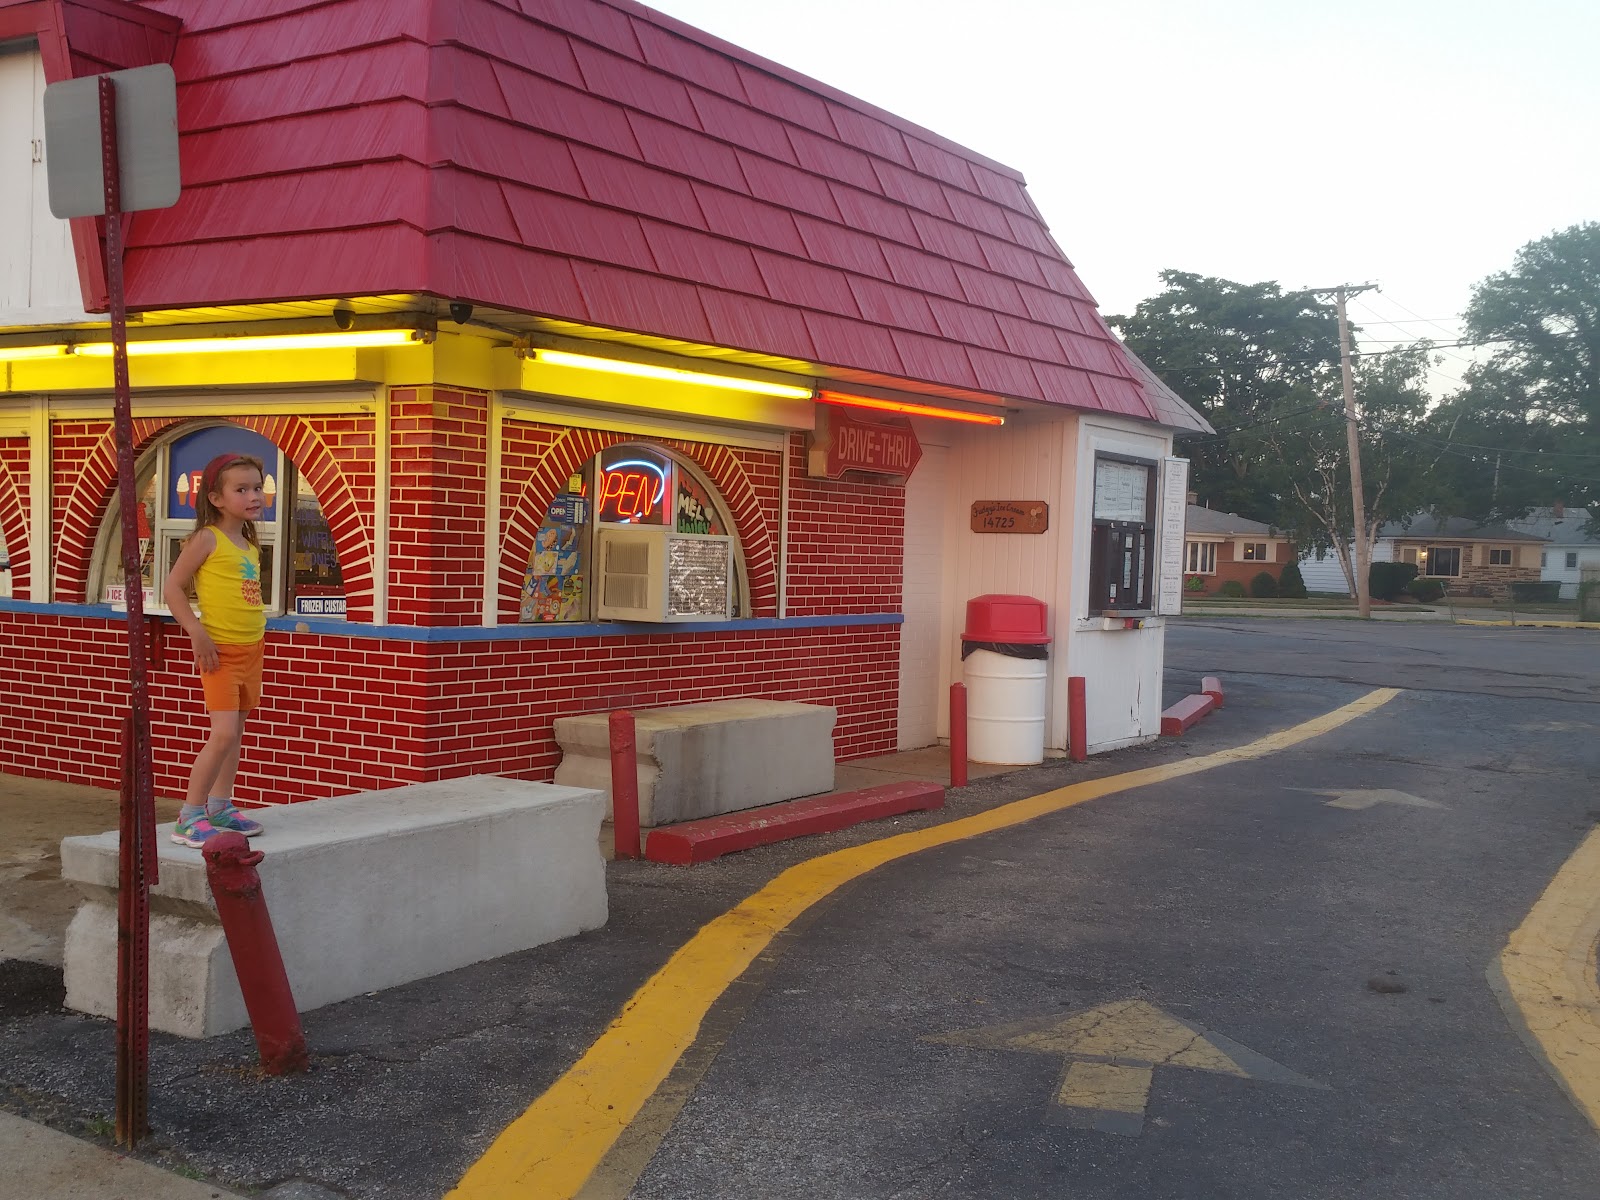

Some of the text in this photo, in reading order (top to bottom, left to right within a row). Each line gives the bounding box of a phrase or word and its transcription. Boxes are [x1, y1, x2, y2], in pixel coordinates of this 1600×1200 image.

[838, 426, 912, 469] DRIVE-THRU
[551, 507, 566, 516] OPEN
[678, 493, 704, 522] MEL
[983, 517, 1015, 528] 14725
[112, 590, 122, 601] ICE
[301, 600, 323, 612] FROZEN
